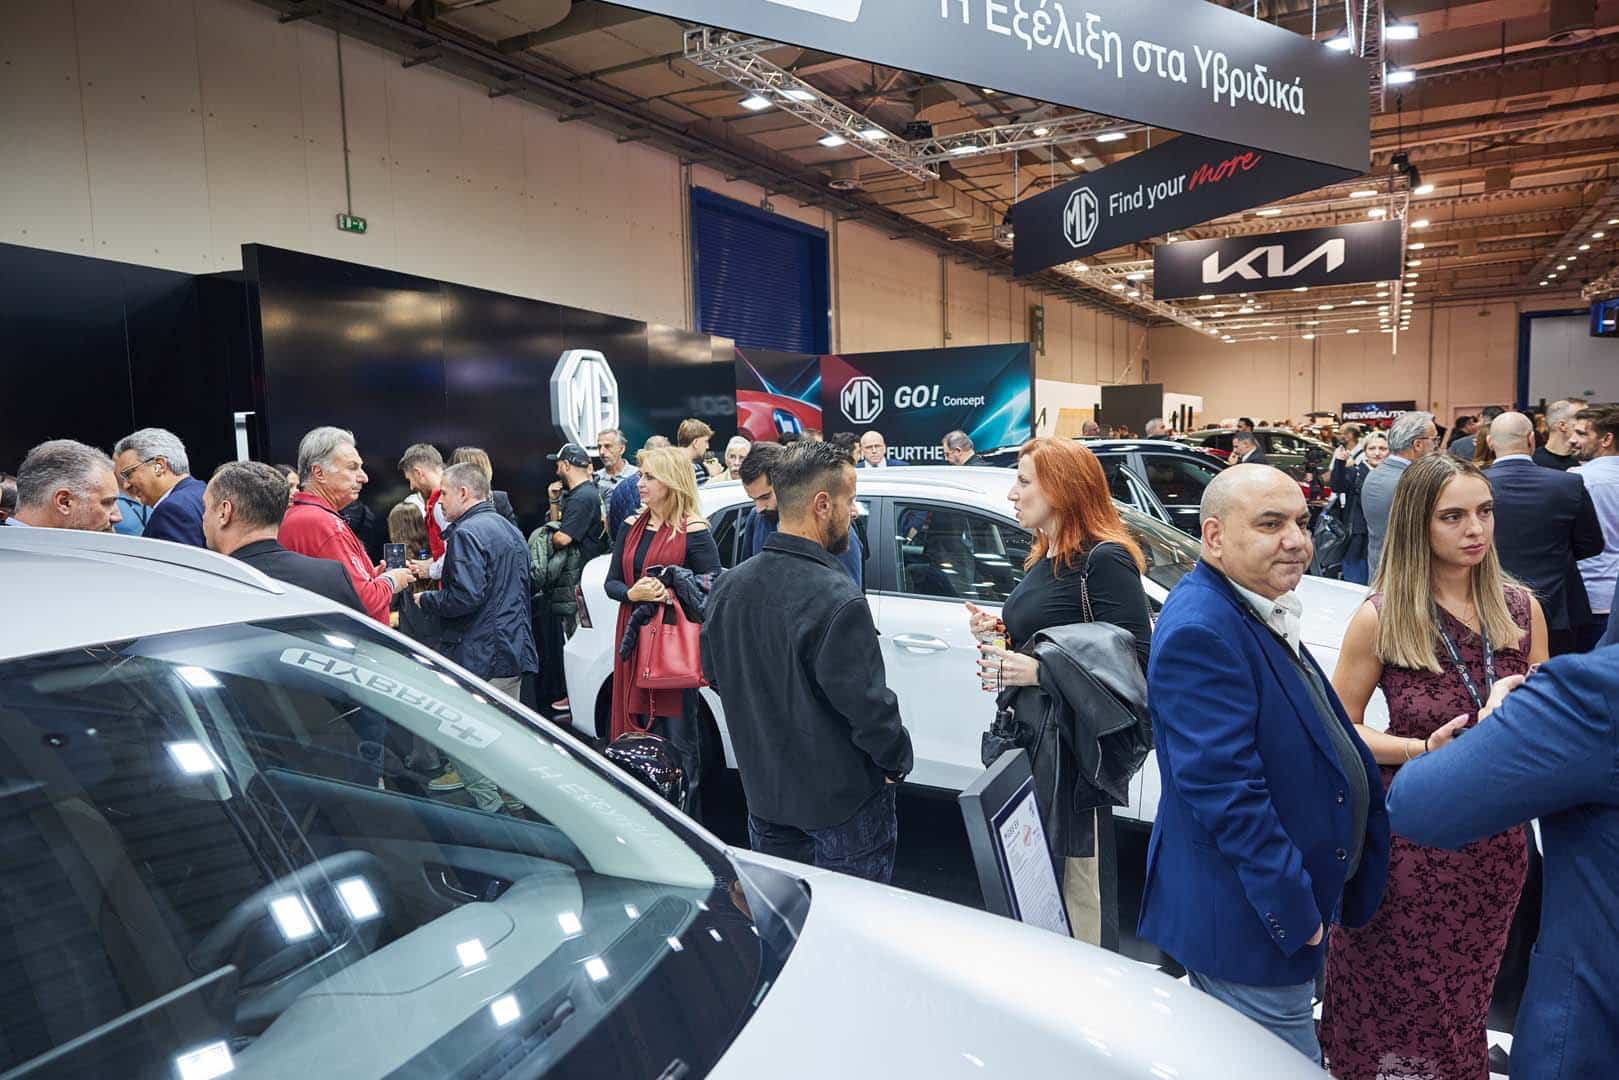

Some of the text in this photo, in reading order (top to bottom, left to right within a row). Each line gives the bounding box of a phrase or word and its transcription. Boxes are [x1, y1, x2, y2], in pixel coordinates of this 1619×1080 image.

[1132, 40, 1188, 84] στα
[1193, 44, 1306, 116] Υβριδικά
[1063, 151, 1262, 249] MG Find your more
[1202, 237, 1346, 284] KIA
[840, 376, 985, 424] MG GO! Concept
[886, 445, 948, 461] FURTHE
